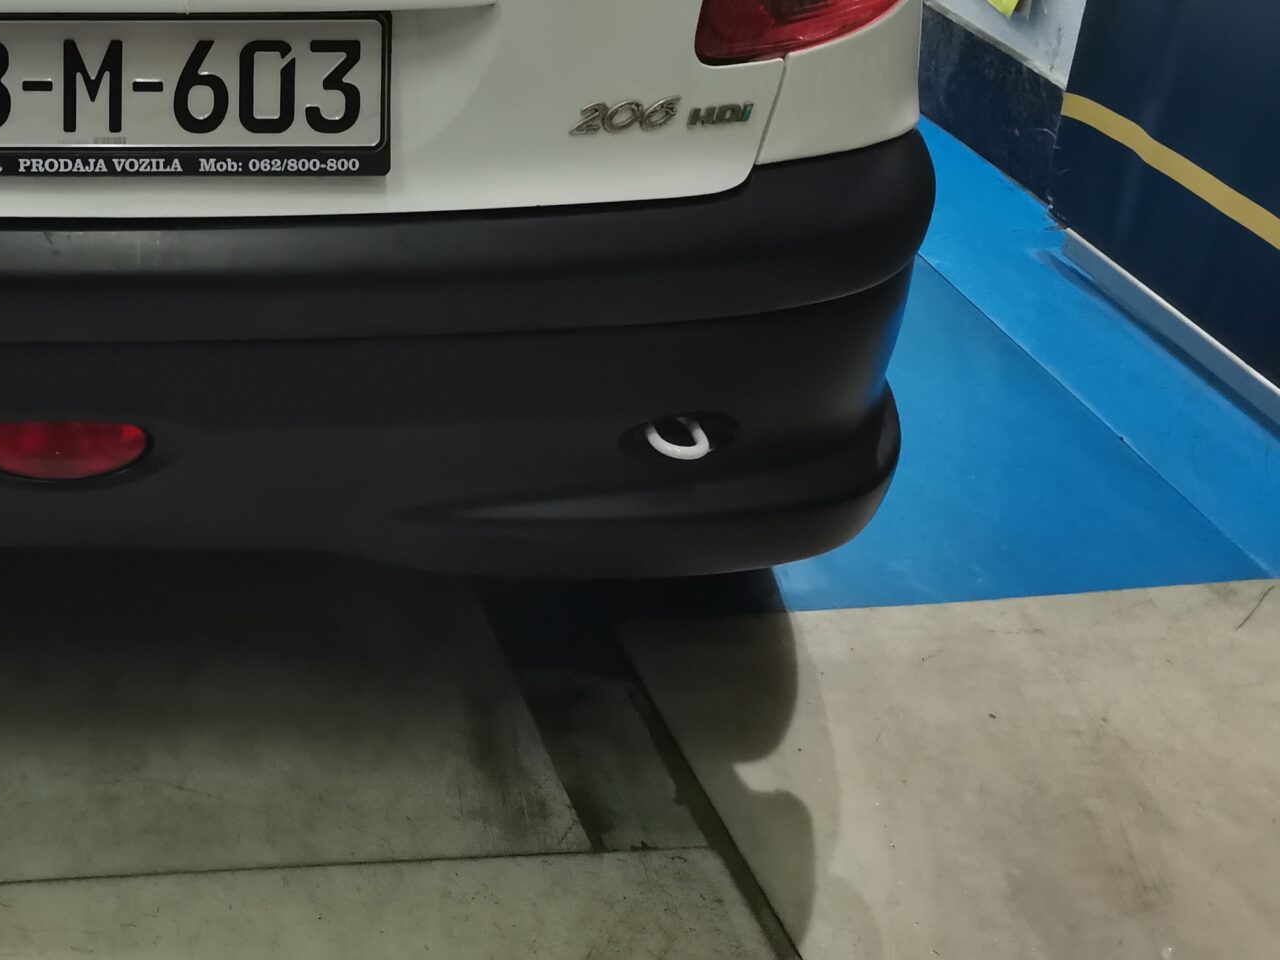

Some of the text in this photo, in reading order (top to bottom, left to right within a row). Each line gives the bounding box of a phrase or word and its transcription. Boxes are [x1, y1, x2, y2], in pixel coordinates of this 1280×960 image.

[568, 95, 681, 136] 206
[18, 158, 108, 173] PRODAJA
[112, 158, 183, 173] VOZILA
[198, 158, 243, 172] Mob:
[248, 158, 360, 173] 062/800-800
